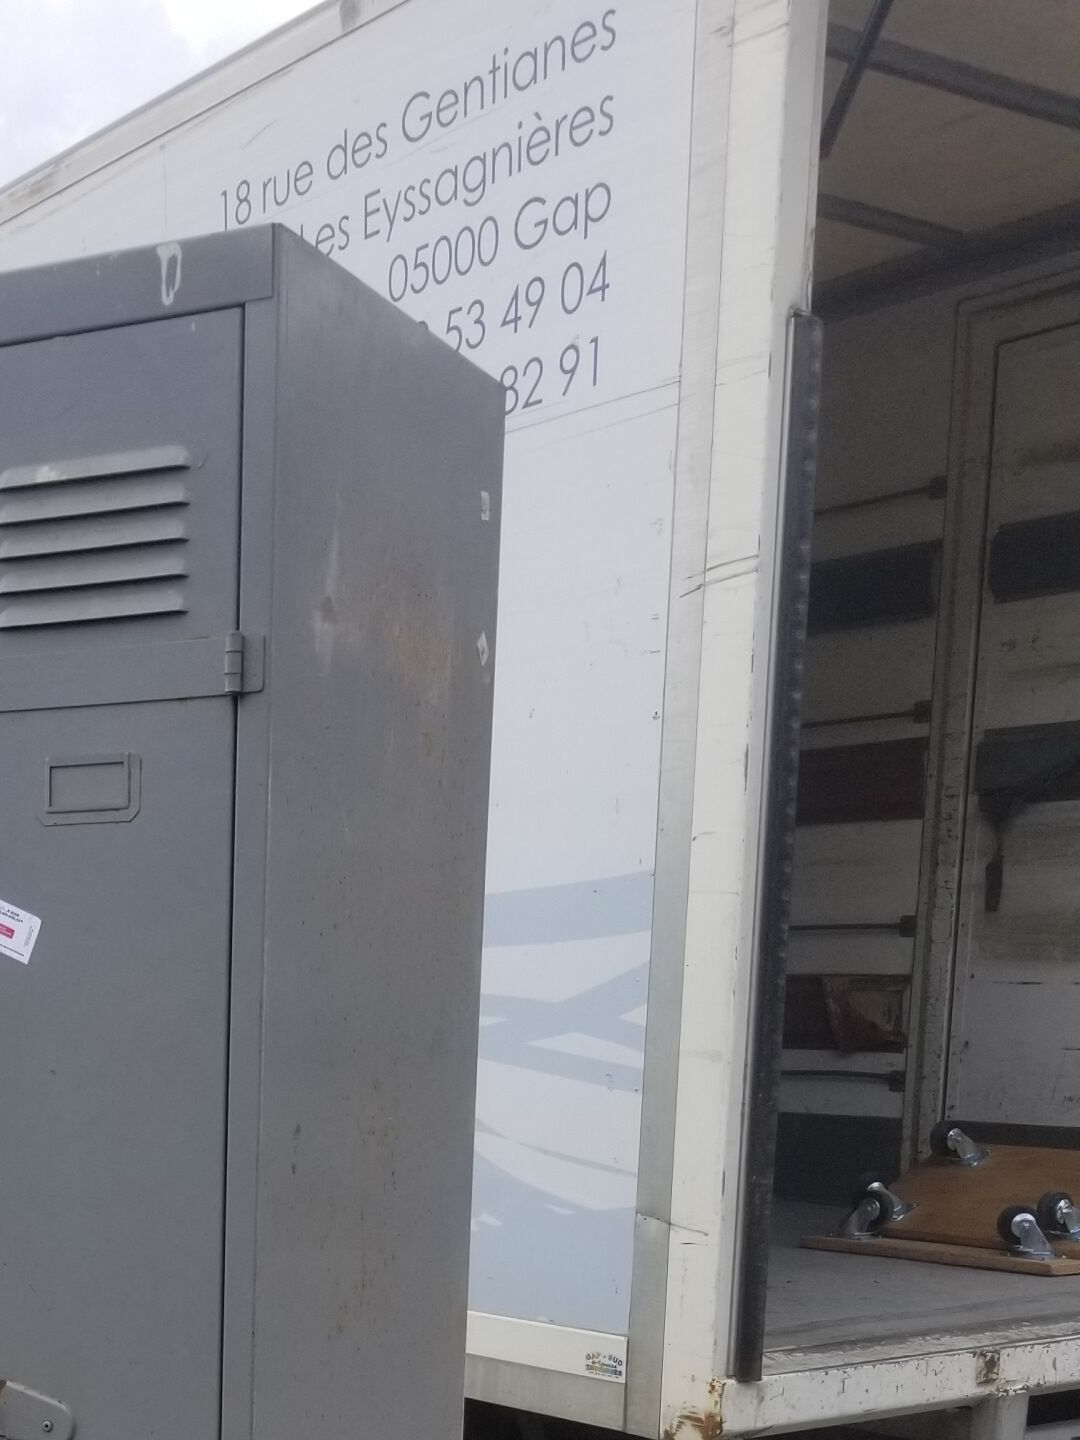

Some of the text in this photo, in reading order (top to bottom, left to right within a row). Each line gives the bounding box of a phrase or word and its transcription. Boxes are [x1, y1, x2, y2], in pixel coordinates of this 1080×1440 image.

[221, 9, 616, 230] 18 rue des Gentianes
[364, 95, 614, 242] Eyssagnières
[388, 182, 612, 302] 05000 Gap
[446, 250, 610, 352] 53 49 04
[500, 337, 599, 416] 82 91
